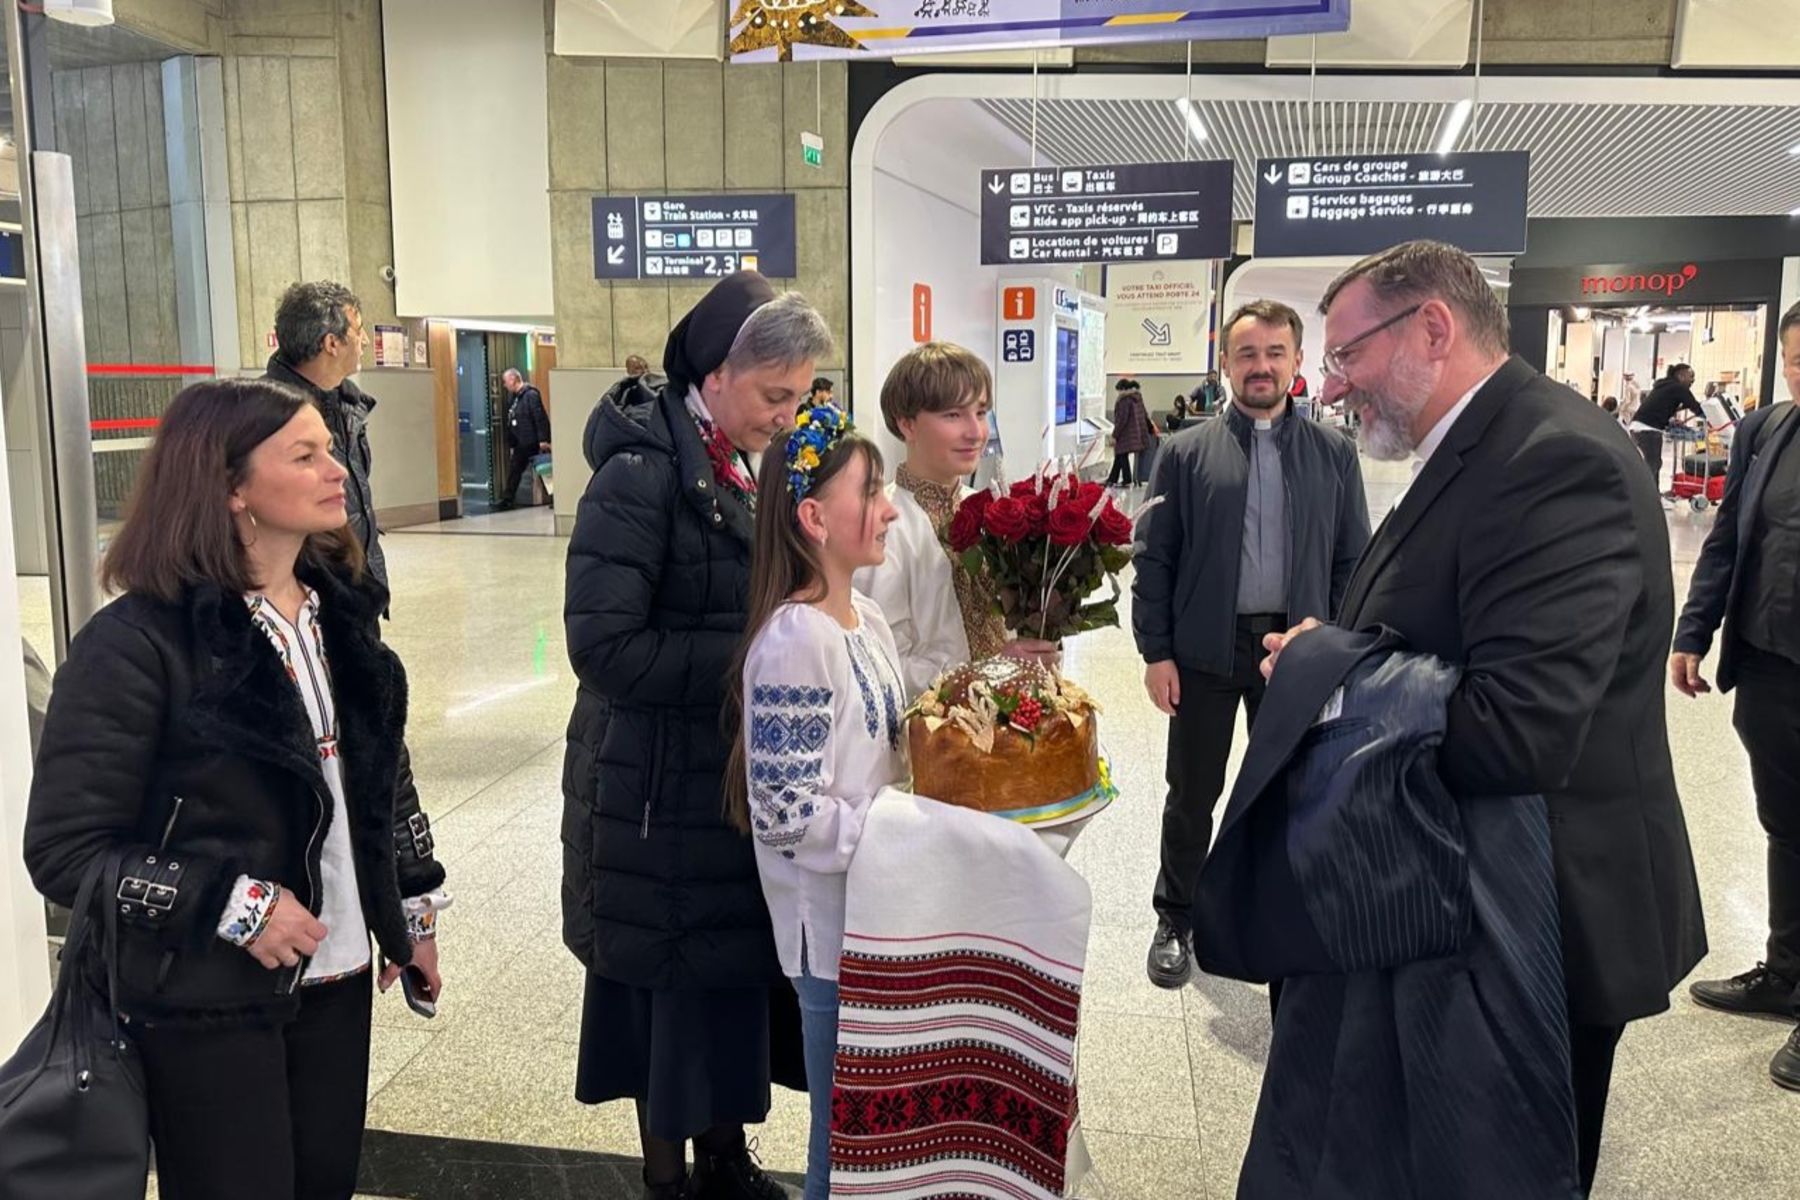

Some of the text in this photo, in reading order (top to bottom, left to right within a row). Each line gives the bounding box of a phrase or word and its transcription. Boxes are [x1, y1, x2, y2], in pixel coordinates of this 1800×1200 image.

[1313, 161, 1408, 174] Cars de groupe
[1034, 173, 1054, 182] Bus
[1086, 170, 1115, 180] Taxis
[1313, 173, 1350, 185] Group
[1355, 171, 1406, 183] Coaches
[663, 202, 685, 210] Gare
[1312, 194, 1412, 206] Service bagages
[1034, 204, 1056, 214] VTC
[1066, 203, 1093, 213] Taxis
[1097, 201, 1144, 212] réservés
[1312, 206, 1366, 220] Baggage
[1369, 203, 1414, 216] Service
[663, 211, 688, 220] Train
[690, 210, 724, 220] Station
[1034, 216, 1058, 227] Ride
[1060, 217, 1082, 228] app
[1085, 214, 1126, 226] pick-up
[1032, 235, 1148, 247] Location de voitures
[1032, 248, 1050, 258] Car
[1054, 248, 1090, 258] Rental
[664, 256, 704, 265] Terminal
[704, 256, 735, 275] 2,3
